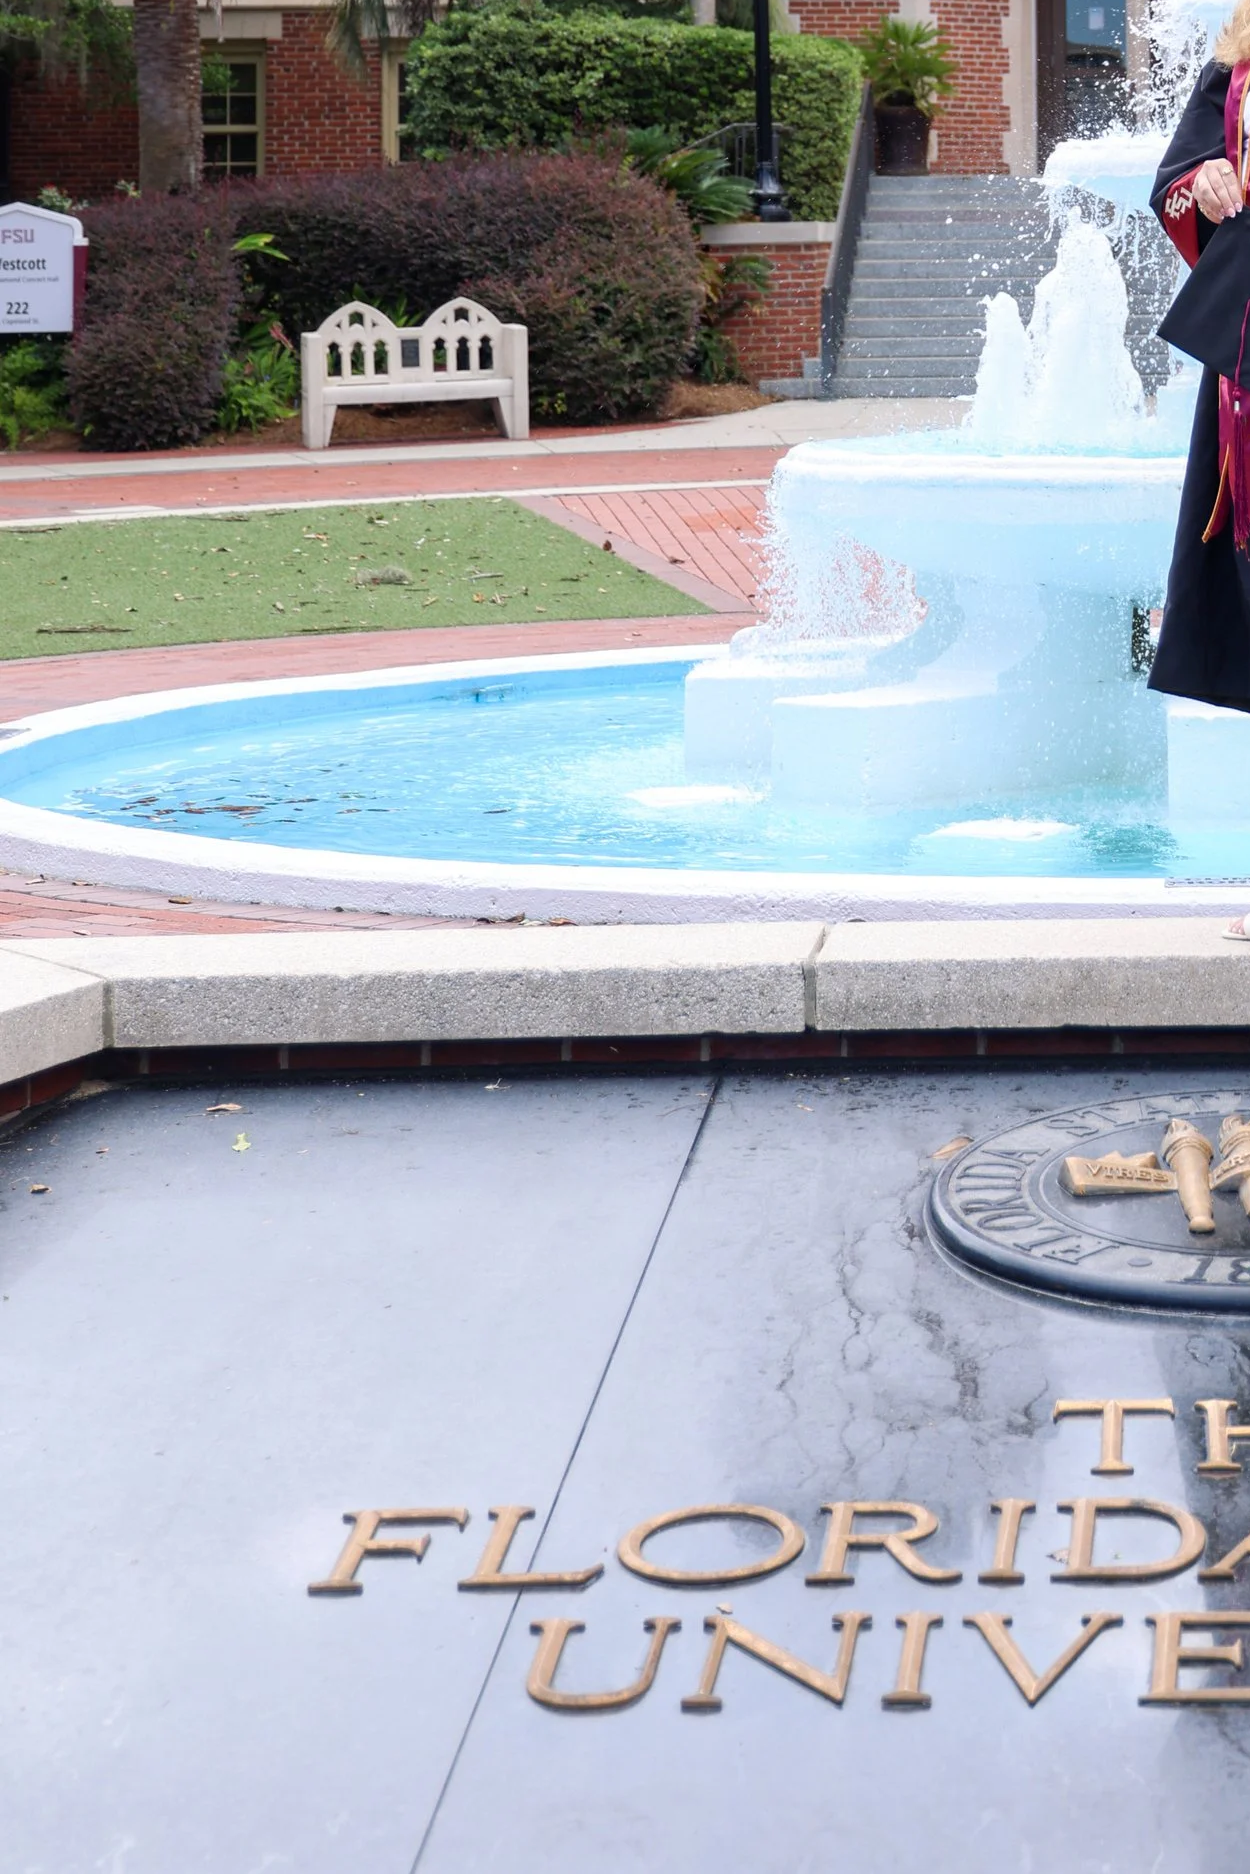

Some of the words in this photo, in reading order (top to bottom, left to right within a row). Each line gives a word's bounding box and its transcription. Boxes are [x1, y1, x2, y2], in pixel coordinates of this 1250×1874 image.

[1165, 187, 1193, 221] FSU
[1, 229, 35, 244] FSU
[0, 258, 46, 271] estcott
[6, 301, 29, 315] 222
[1086, 1162, 1169, 1183] VIRES
[955, 1148, 1119, 1264] FLORIDA
